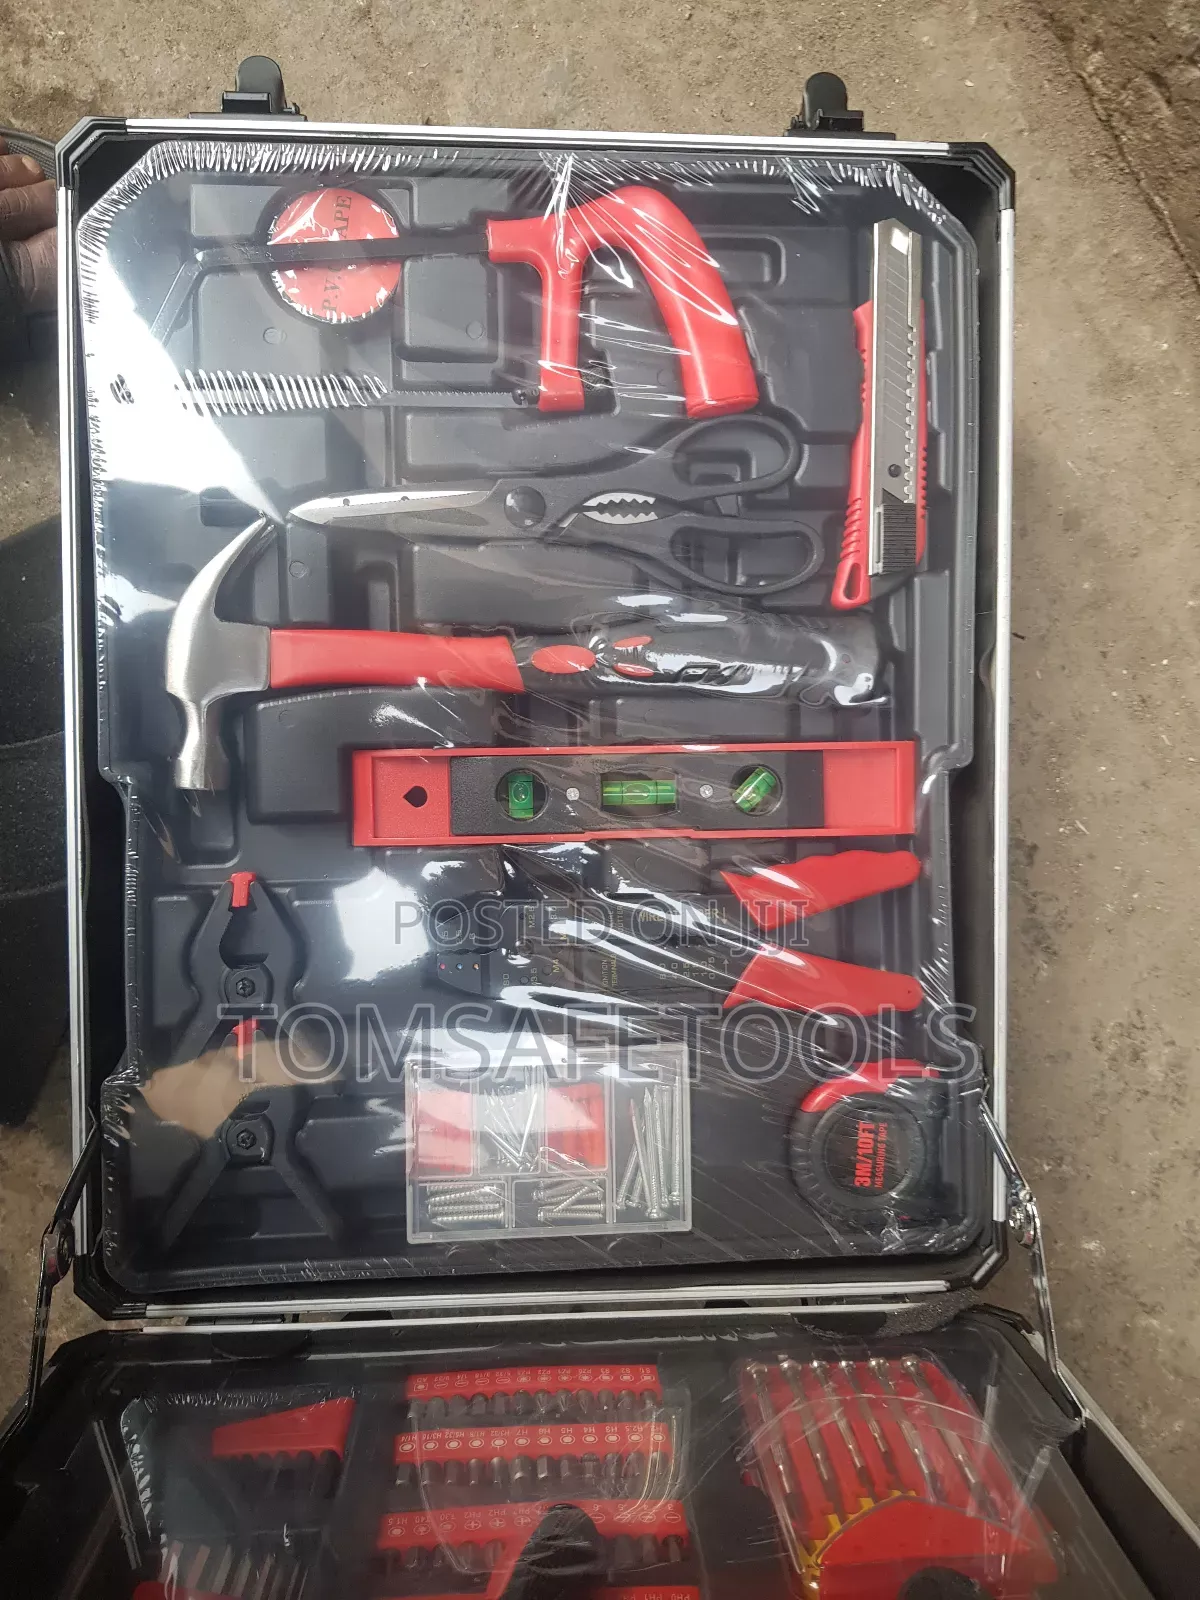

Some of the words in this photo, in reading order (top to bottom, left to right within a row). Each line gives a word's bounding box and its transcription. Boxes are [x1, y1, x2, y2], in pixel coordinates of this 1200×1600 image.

[333, 196, 352, 239] APE
[878, 1122, 888, 1141] TAPE
[874, 1142, 887, 1189] MEASURING
